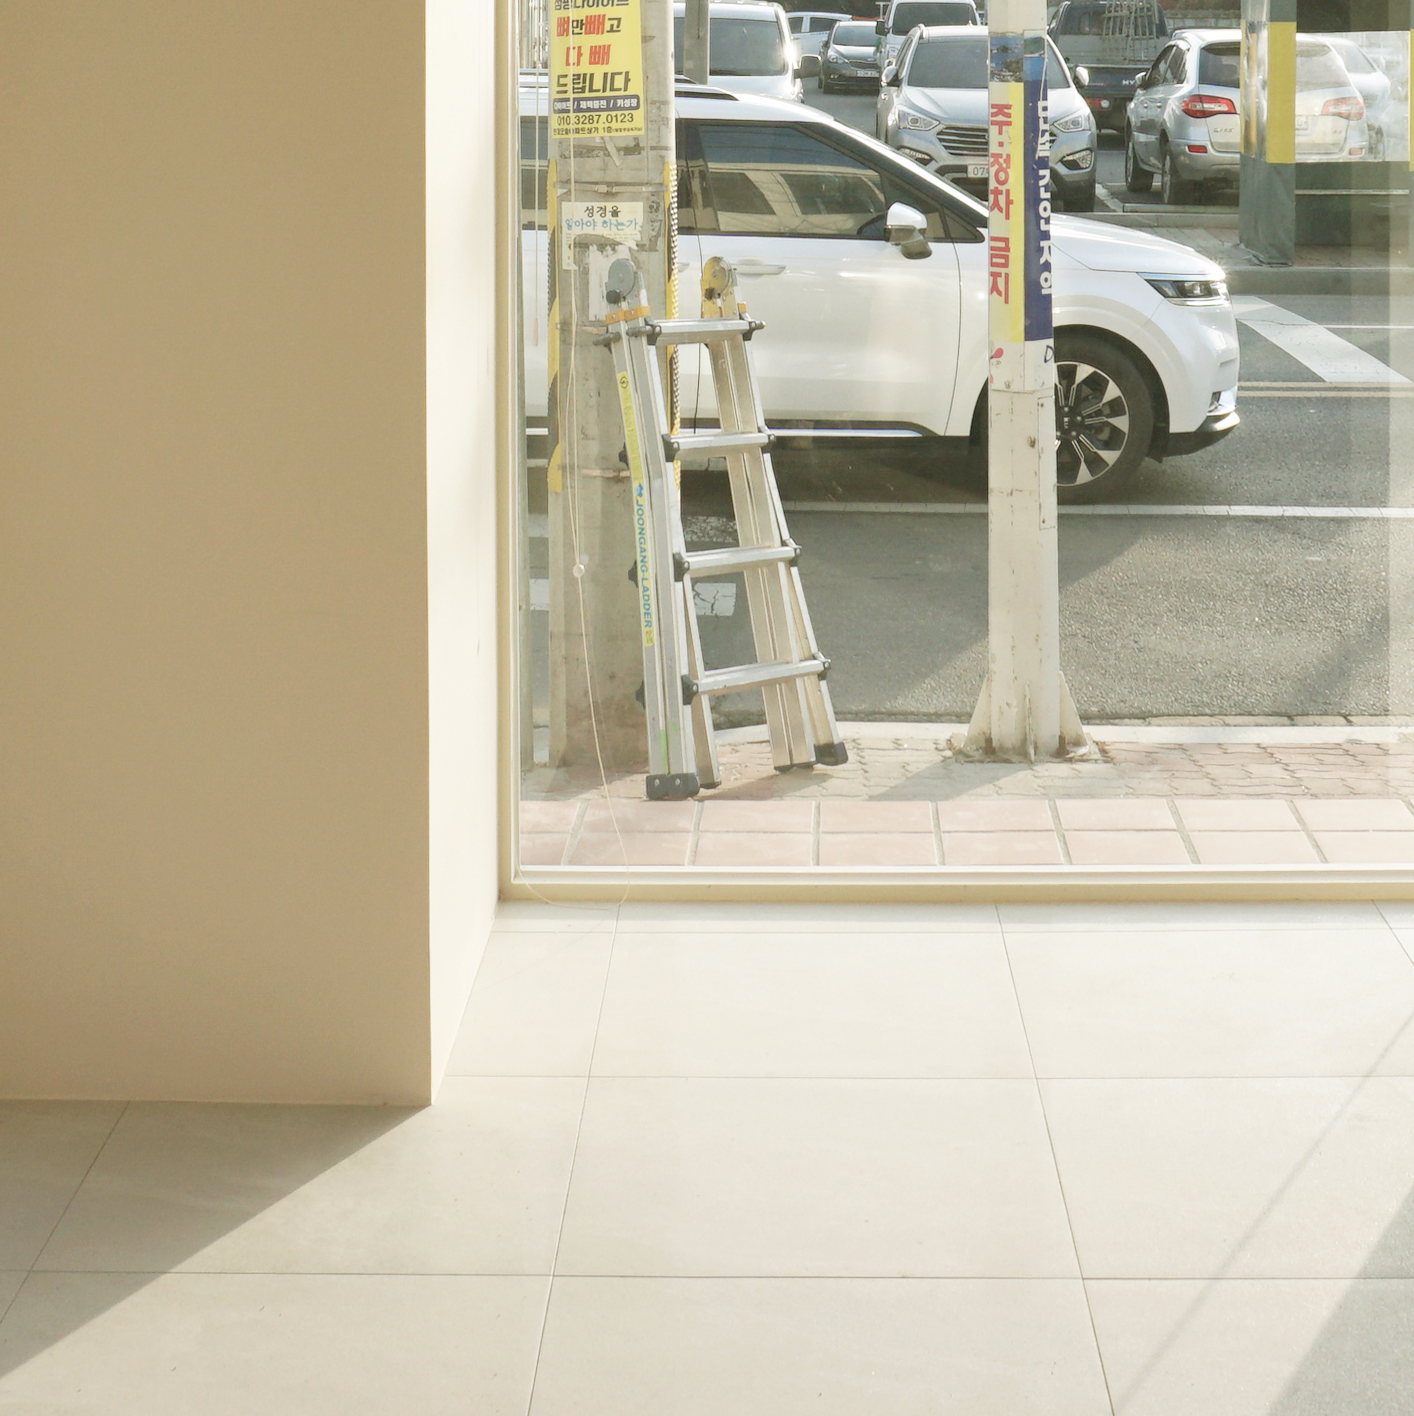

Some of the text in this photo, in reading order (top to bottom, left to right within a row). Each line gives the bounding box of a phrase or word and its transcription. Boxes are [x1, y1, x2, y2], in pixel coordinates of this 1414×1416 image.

[556, 71, 631, 95] 드립니다
[557, 112, 634, 126] 010.3287.0123
[584, 205, 621, 218] 성경을
[601, 218, 638, 231] 하는가
[990, 236, 1011, 305] 금지
[636, 499, 652, 628] JOONGANG-LADDER
